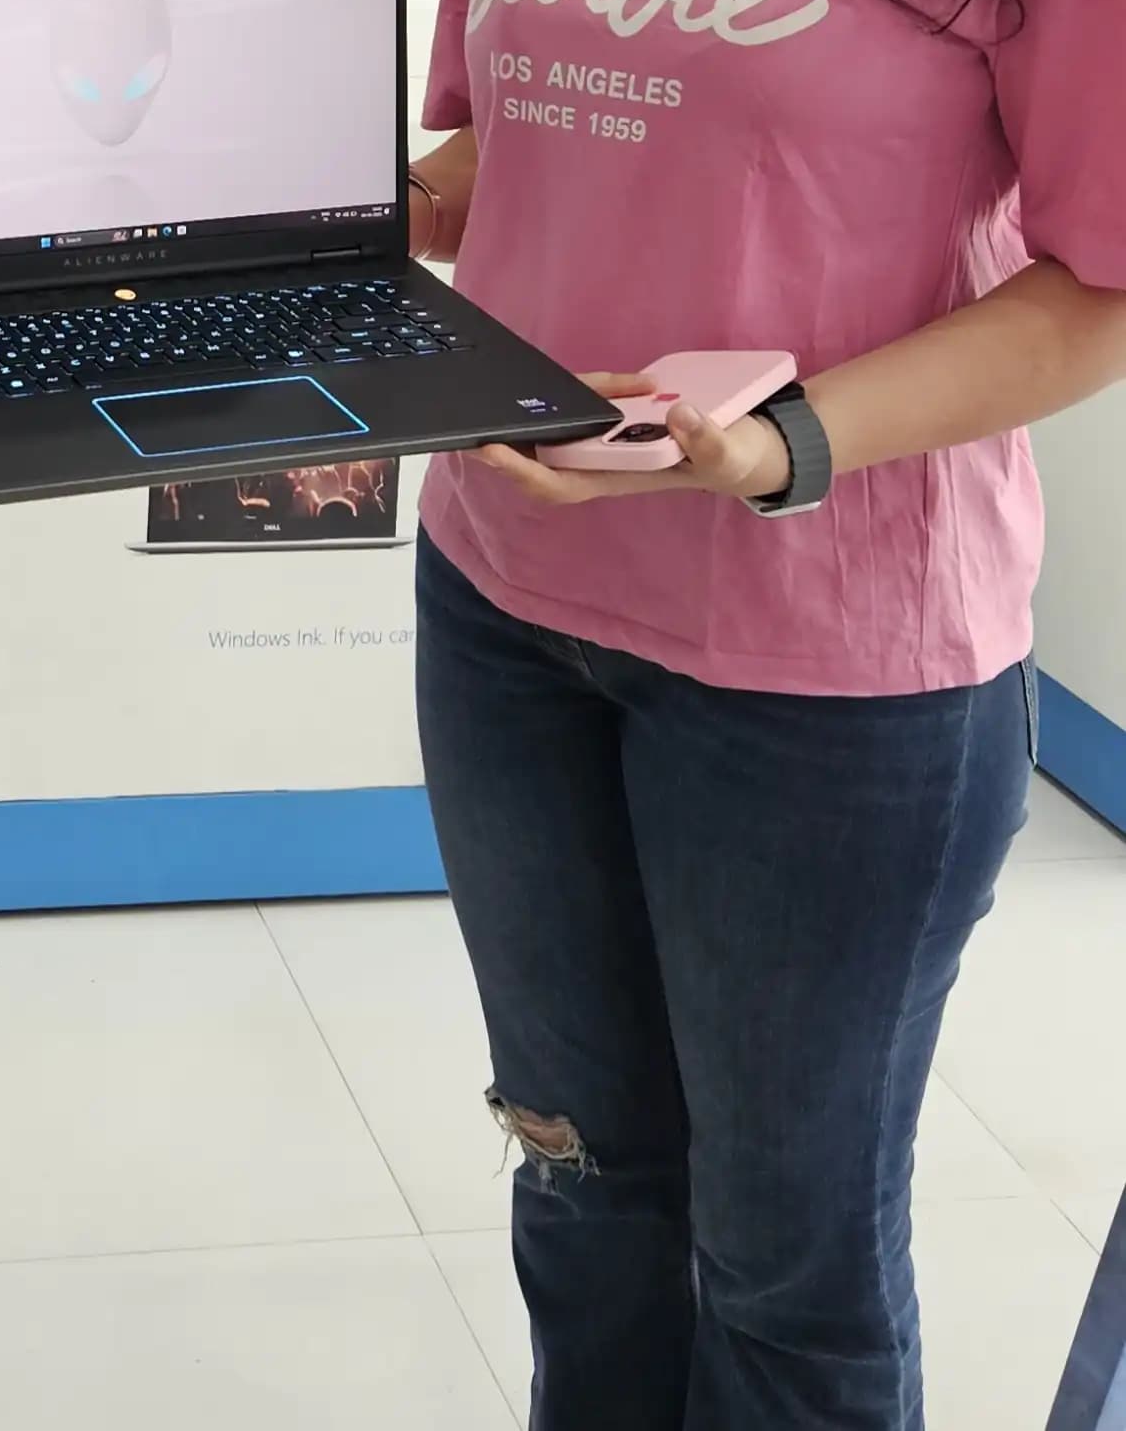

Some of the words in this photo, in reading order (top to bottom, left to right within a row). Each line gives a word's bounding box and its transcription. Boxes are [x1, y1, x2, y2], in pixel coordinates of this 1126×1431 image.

[490, 50, 533, 83] LOS
[546, 62, 684, 107] ANGELES
[503, 98, 576, 130] SINCE
[588, 112, 647, 143] 1959
[208, 629, 291, 649] Windows
[297, 628, 326, 646] Ink.
[333, 626, 346, 645] If
[350, 630, 382, 648] you
